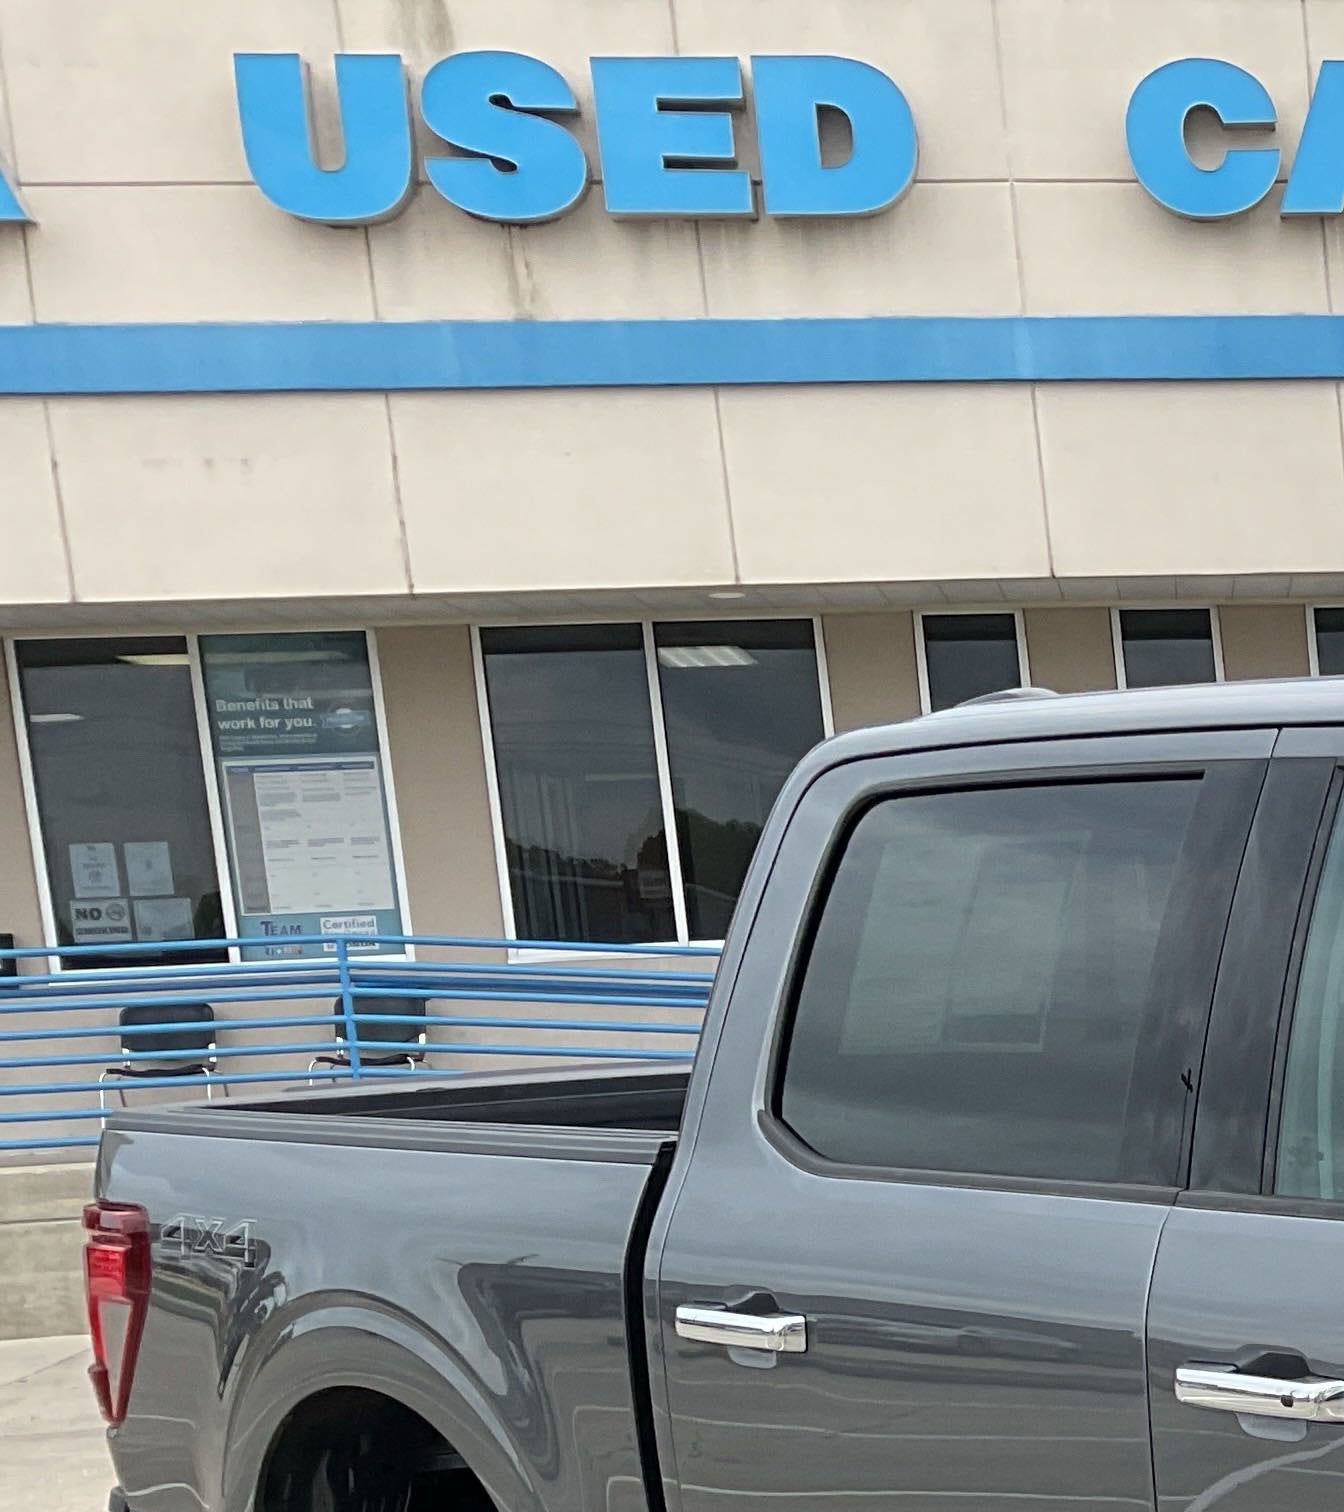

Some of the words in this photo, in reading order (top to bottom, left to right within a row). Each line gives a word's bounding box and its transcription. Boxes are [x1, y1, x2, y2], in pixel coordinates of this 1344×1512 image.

[234, 50, 918, 224] USED
[215, 696, 279, 712] Benefits
[283, 696, 314, 710] that
[217, 716, 256, 730] work
[260, 715, 280, 729] for
[75, 907, 102, 921] NO
